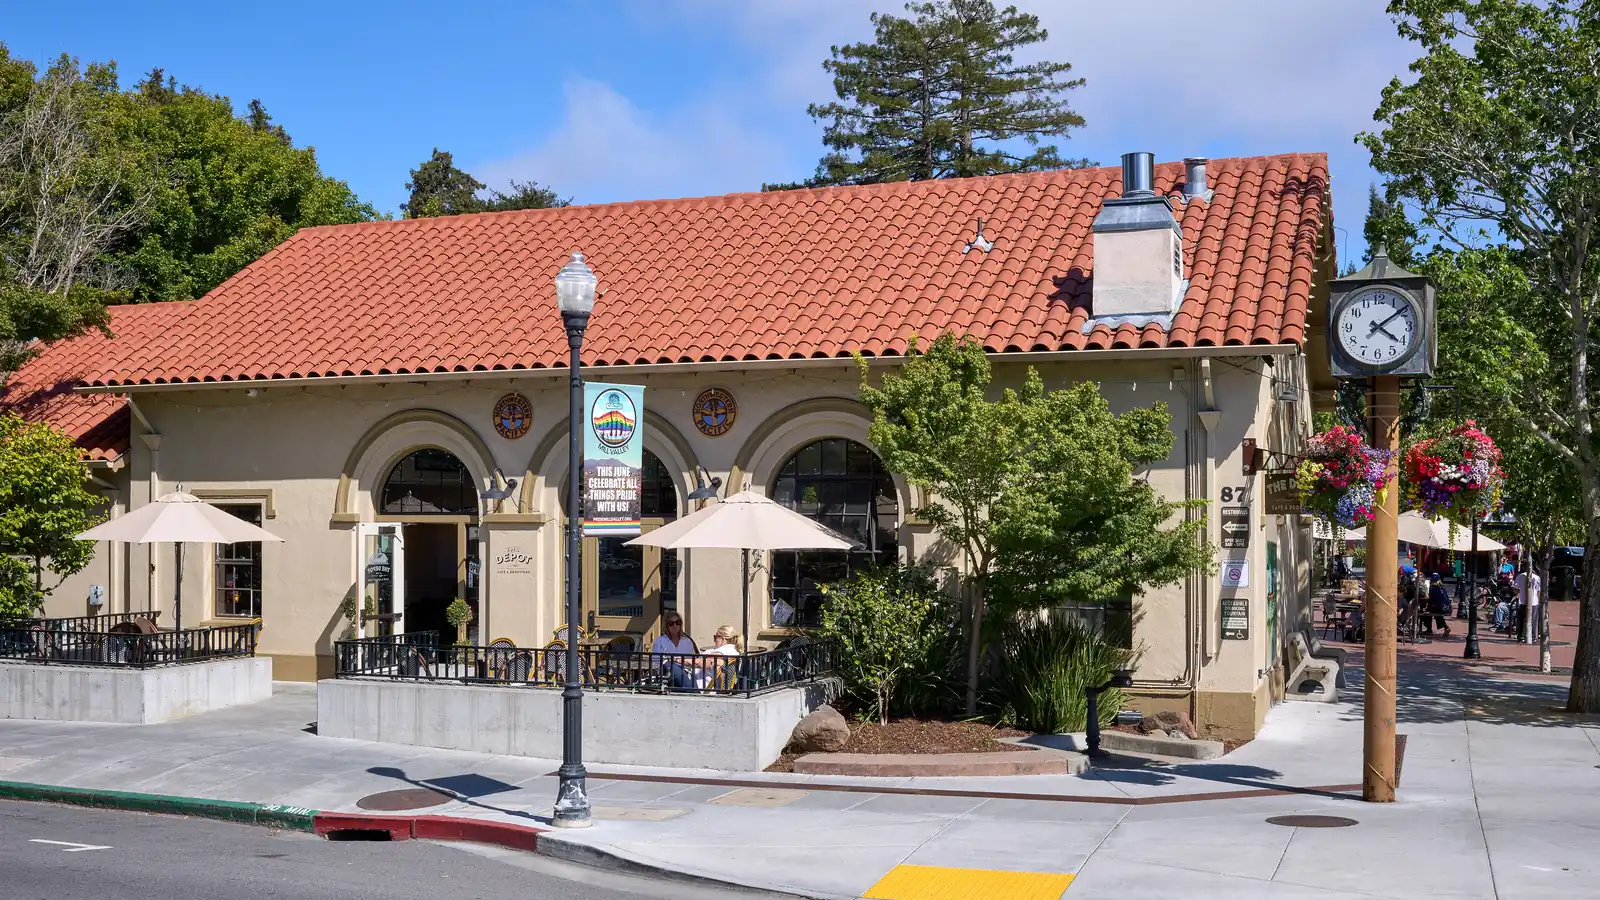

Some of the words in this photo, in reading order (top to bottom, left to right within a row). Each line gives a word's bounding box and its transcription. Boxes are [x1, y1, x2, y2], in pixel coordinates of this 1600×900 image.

[1363, 299, 1369, 308] 11
[1374, 294, 1385, 305] 12
[1392, 297, 1395, 308] 1
[1351, 308, 1361, 318] 10
[1401, 308, 1408, 317] 2
[1345, 323, 1352, 333] 9
[1405, 321, 1412, 331] 3
[1350, 335, 1357, 346] 8
[1399, 335, 1406, 345] 4
[1360, 345, 1367, 356] 7
[1374, 349, 1381, 359] 6
[1389, 346, 1396, 355] 5
[495, 423, 528, 437] PACIFIC
[697, 419, 732, 434] PACIFIC
[597, 443, 610, 455] MILL
[610, 444, 629, 455] VALLEY
[597, 467, 612, 476] THIS
[614, 467, 630, 476] JUNE
[588, 478, 625, 488] CELEBRATE
[626, 478, 637, 488] ALL
[1267, 479, 1287, 495] THE
[590, 490, 615, 500] THINGS
[616, 490, 636, 500] PRIDE
[1220, 486, 1246, 502] 87
[597, 502, 615, 511] WITH
[617, 502, 629, 511] US!
[496, 553, 532, 564] DEPOT
